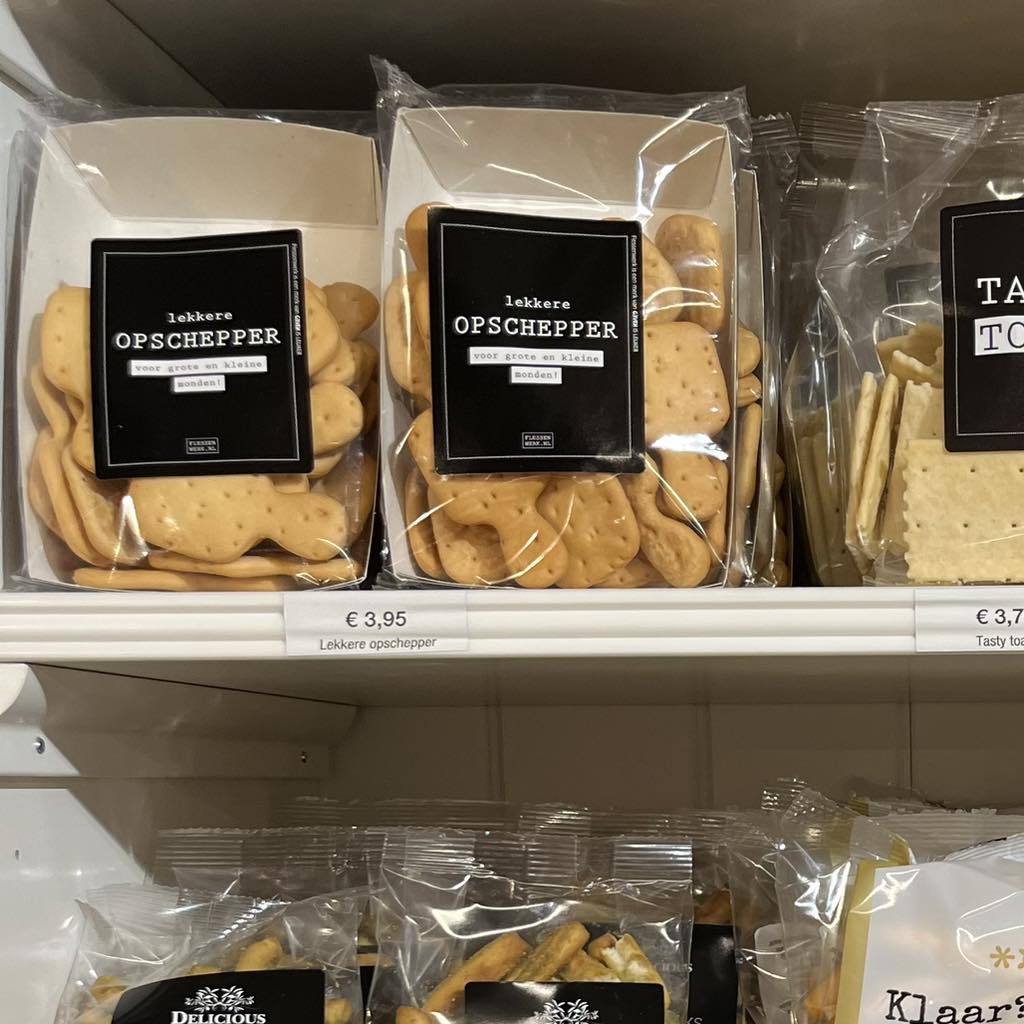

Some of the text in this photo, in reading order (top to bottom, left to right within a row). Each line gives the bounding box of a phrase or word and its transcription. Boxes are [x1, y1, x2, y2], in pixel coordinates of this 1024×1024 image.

[505, 295, 571, 310] lekkere
[166, 310, 233, 324] lekkere
[453, 316, 619, 339] OPSCHEPPER
[114, 327, 281, 349] OPSCHEPPER
[473, 352, 600, 363] voor grote en kleine
[514, 369, 559, 380] monden!
[177, 378, 223, 388] monden!
[345, 611, 407, 630] € 3,95
[976, 609, 989, 625] €
[320, 637, 438, 652] Lekkere opschepper
[976, 635, 1007, 649] Tasty
